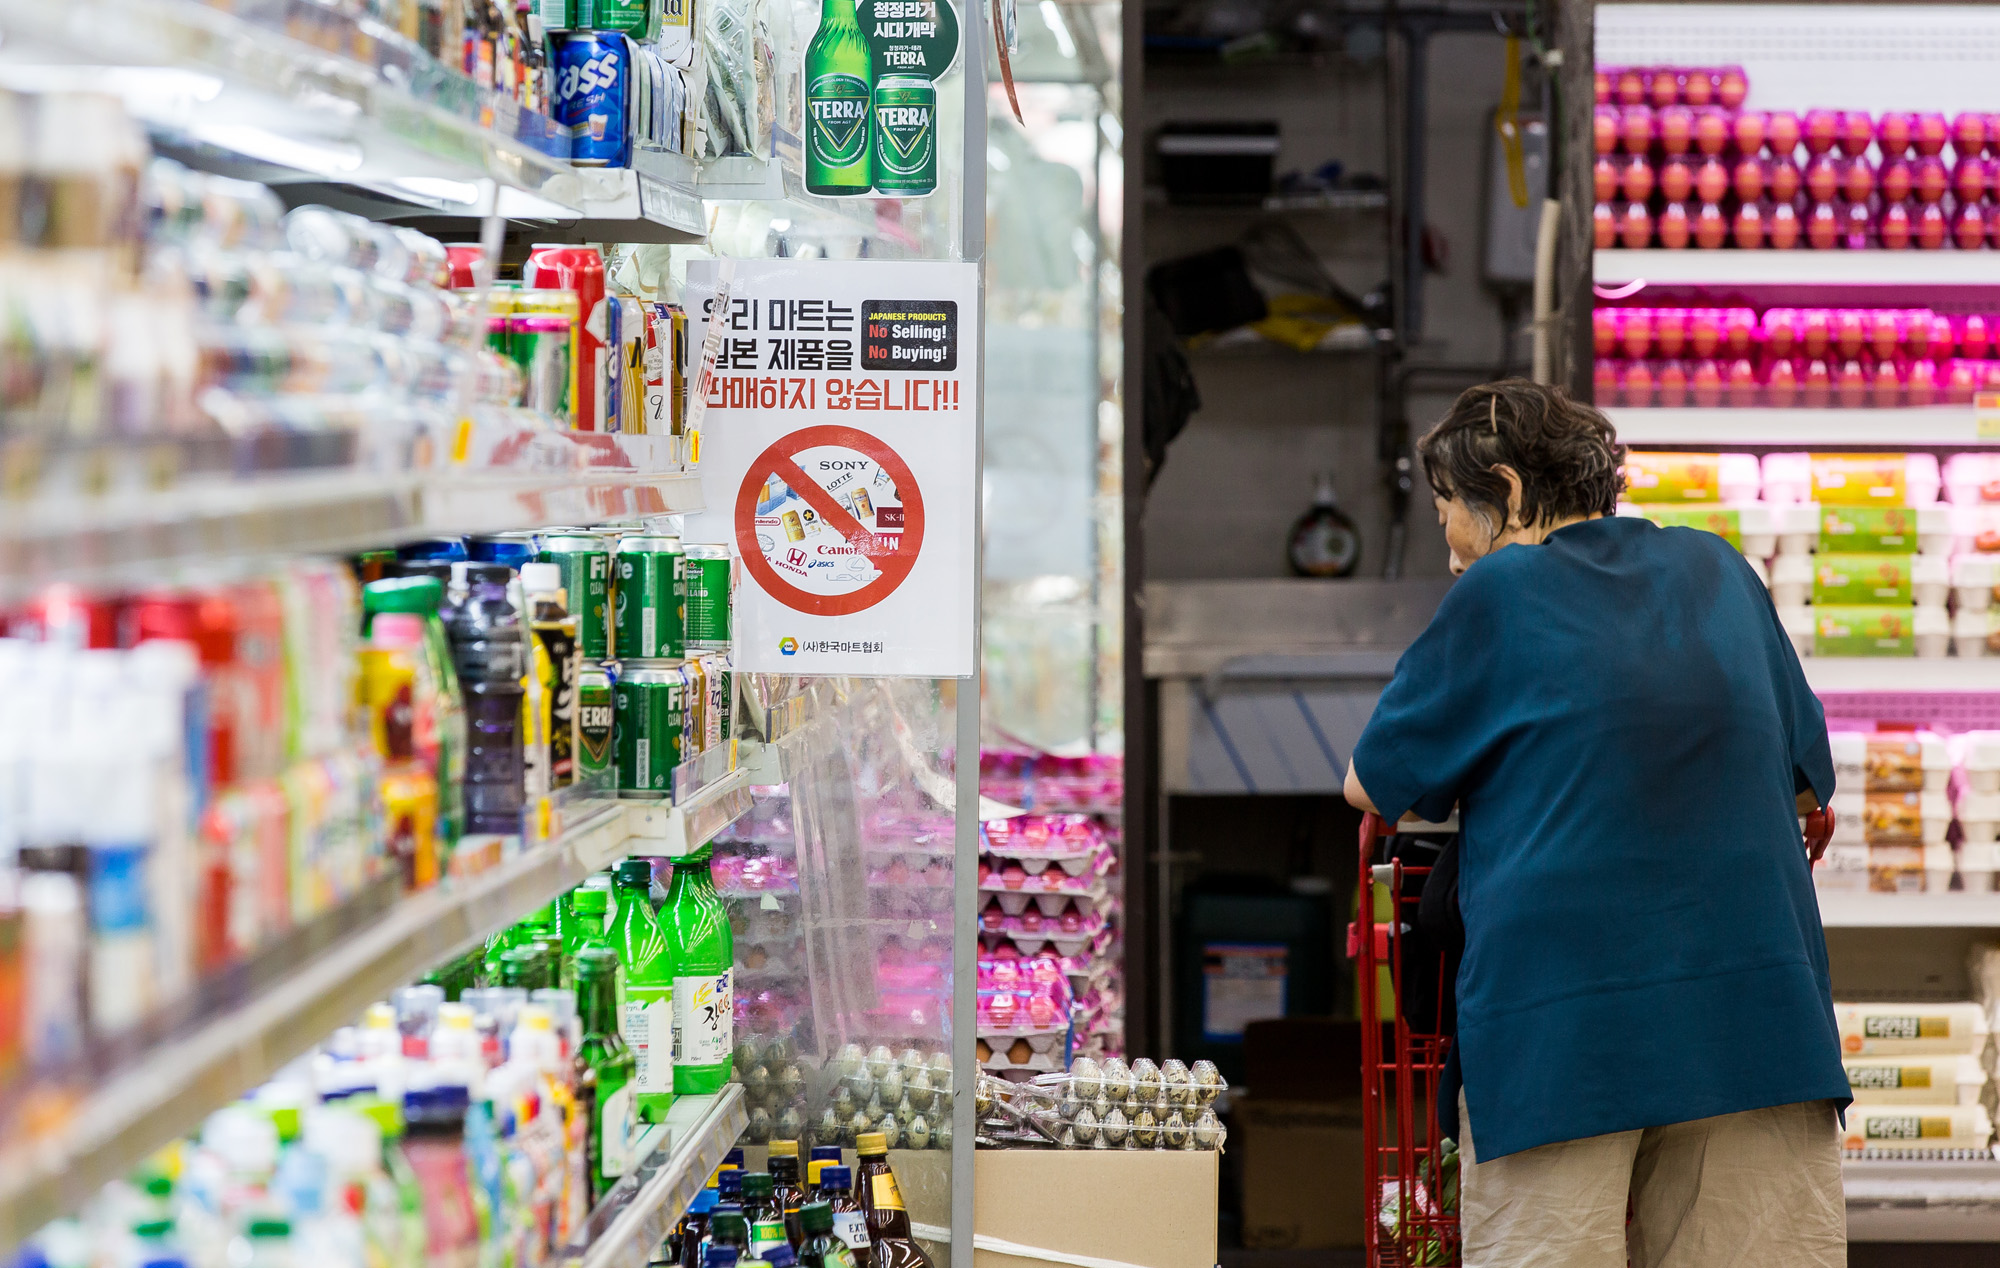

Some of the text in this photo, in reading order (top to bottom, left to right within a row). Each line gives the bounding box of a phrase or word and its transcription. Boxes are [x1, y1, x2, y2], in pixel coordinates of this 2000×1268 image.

[874, 1, 936, 18] 청정라거
[883, 52, 926, 66] TERRA
[553, 53, 619, 105] ass
[812, 101, 865, 120] TERRA
[879, 107, 929, 127] TERRA
[769, 299, 854, 331] 마트는
[908, 313, 946, 321] PRODUCTS
[869, 324, 947, 341] No Selling!
[768, 338, 853, 370] 제품을
[868, 345, 947, 363] No Buying!
[706, 376, 959, 411] 판매하지 않습니다!!
[819, 461, 869, 470] SONY
[826, 472, 854, 491] LOTTE
[884, 513, 905, 522] SK-II
[775, 560, 809, 578] HONDA
[686, 589, 708, 597] LLAND
[802, 640, 883, 654] (사)한국마트협회
[580, 706, 612, 727] ERRA
[760, 1226, 778, 1240] 100%
[854, 1233, 869, 1244] COL
